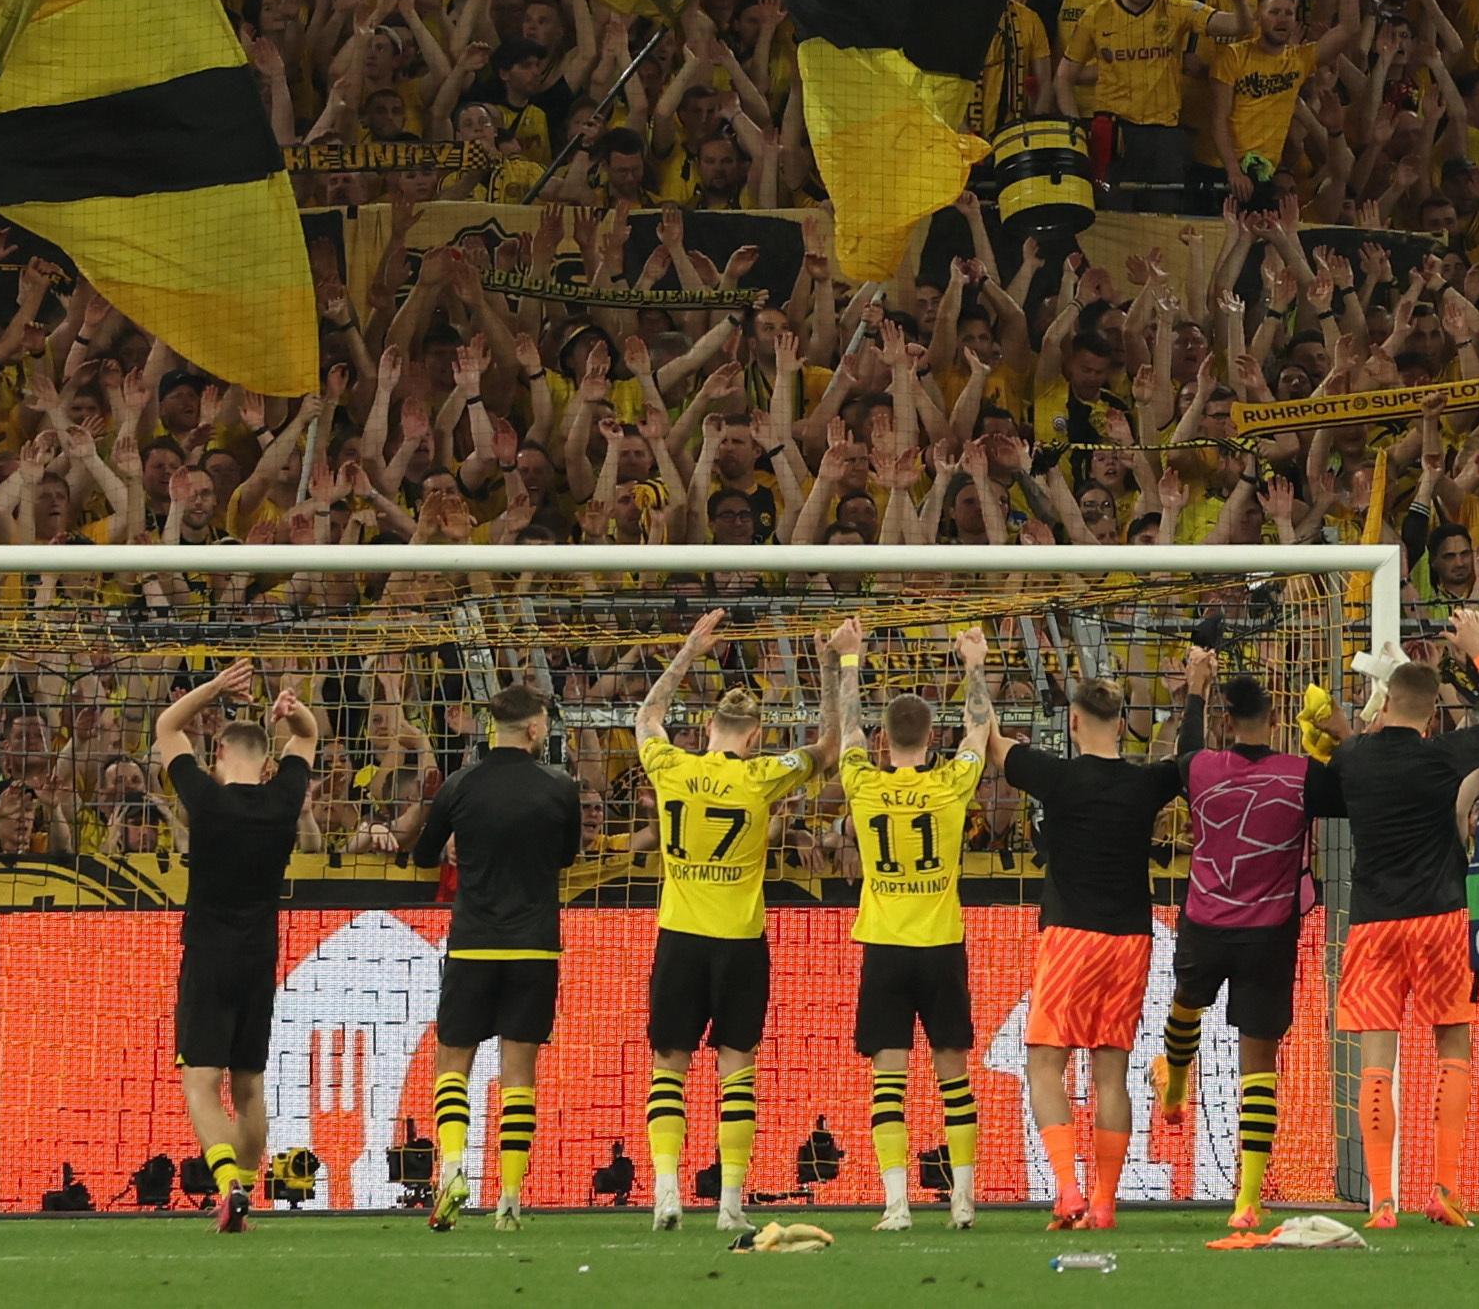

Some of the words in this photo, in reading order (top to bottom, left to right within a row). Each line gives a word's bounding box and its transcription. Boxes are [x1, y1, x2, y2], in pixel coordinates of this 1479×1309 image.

[1113, 45, 1175, 63] EVONIK
[1242, 398, 1351, 424] RUHRPOTT
[685, 775, 734, 798] WOLF
[880, 789, 931, 809] REUS
[663, 799, 752, 863] 17
[868, 812, 942, 877] 11
[668, 861, 743, 882] DORTMUND
[870, 876, 949, 894] DORTMUND
